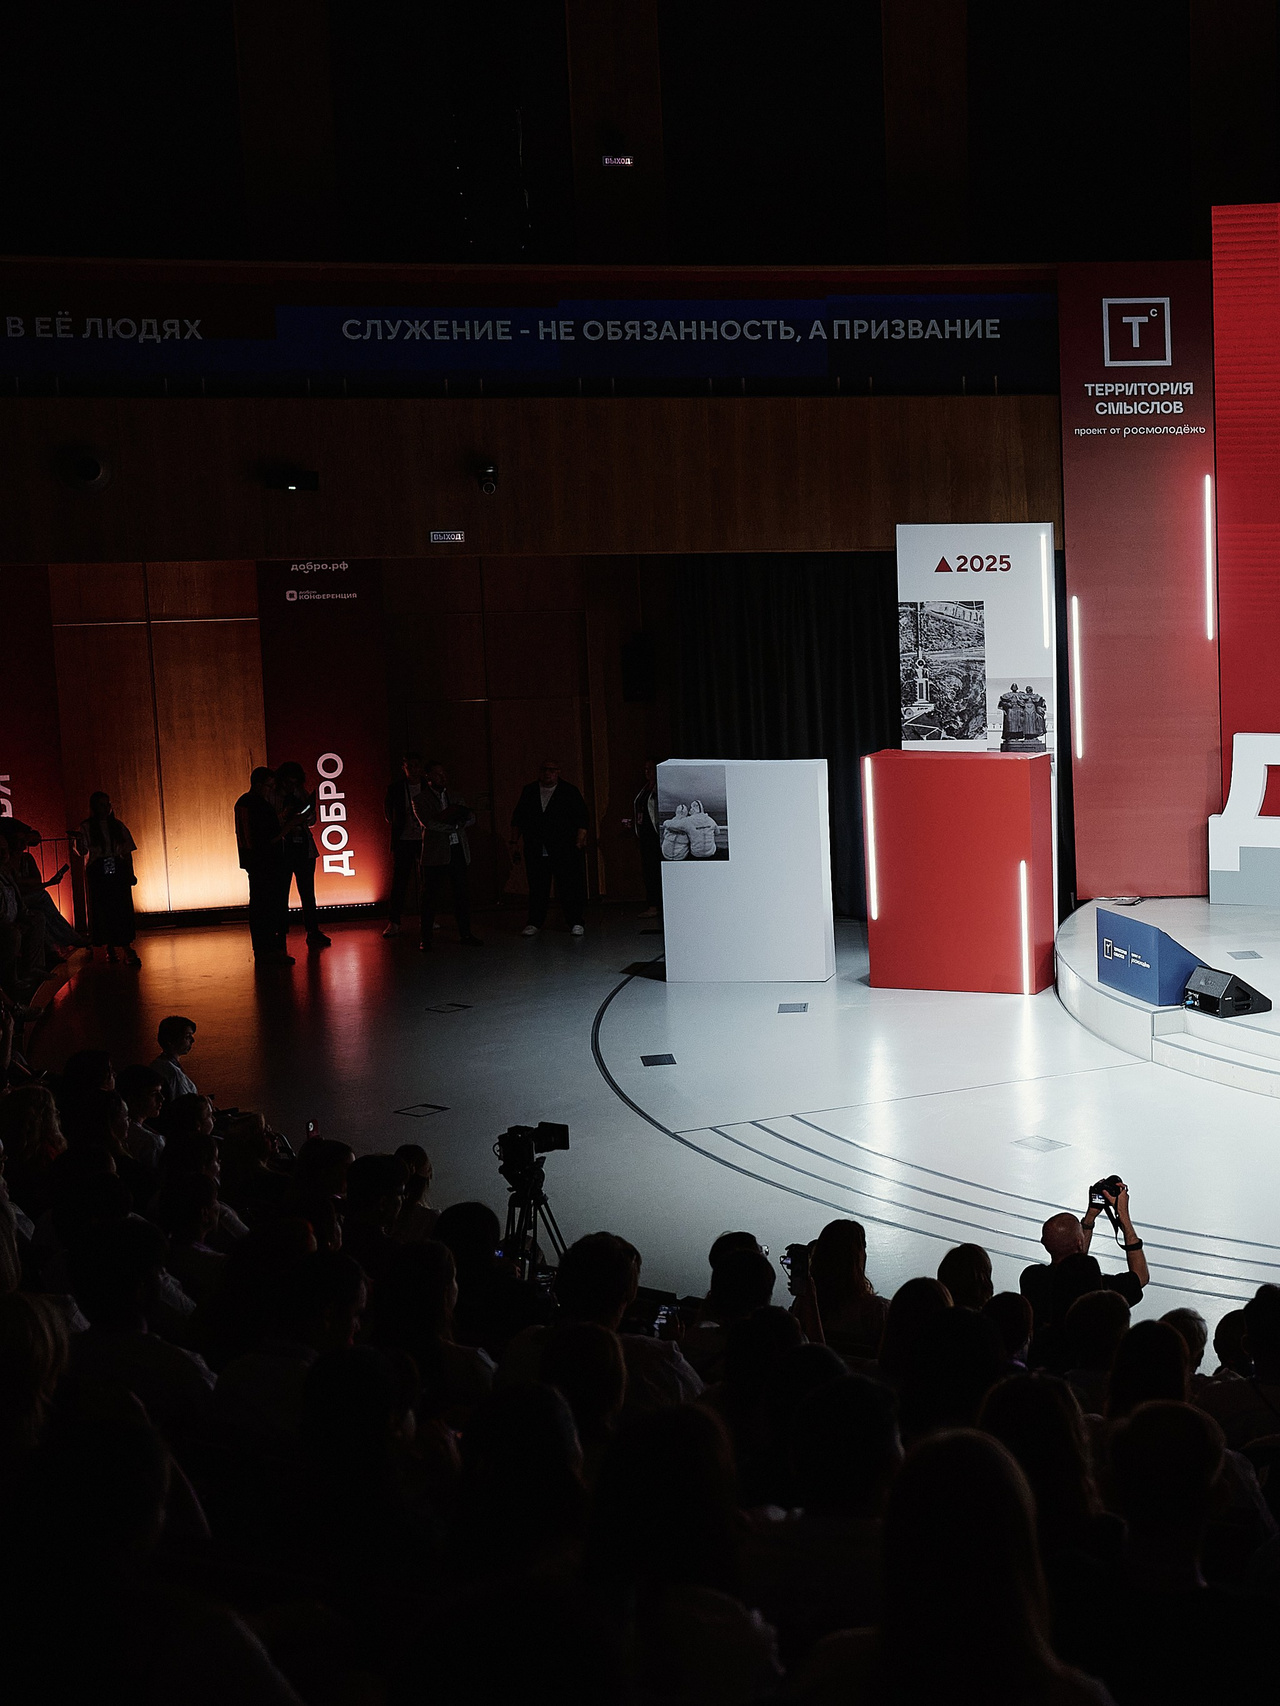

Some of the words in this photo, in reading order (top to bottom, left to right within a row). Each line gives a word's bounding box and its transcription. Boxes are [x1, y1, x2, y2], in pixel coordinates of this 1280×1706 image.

[5, 316, 26, 338] В
[35, 310, 74, 339] ЕЁ
[82, 318, 204, 343] ЛЮДЯХ
[341, 319, 513, 341] СЛУЖЕНИЕ
[538, 320, 576, 341] НЕ
[582, 319, 803, 343] ОБЯЗАННОСТЬ,
[808, 319, 828, 340] А
[832, 318, 1001, 340] ПРИЗВАНИЕ
[1084, 382, 1194, 397] ТЕРРИТОРИЯ
[1095, 401, 1184, 415] СМЫСЛОВ
[1074, 427, 1108, 436] проект
[1110, 426, 1121, 435] от
[1123, 424, 1207, 438] росмолодёжь
[433, 533, 462, 541] ВЫХОД
[290, 560, 349, 573] добро.рф
[956, 554, 1012, 572] 2025
[316, 752, 356, 877] ДОБРО
